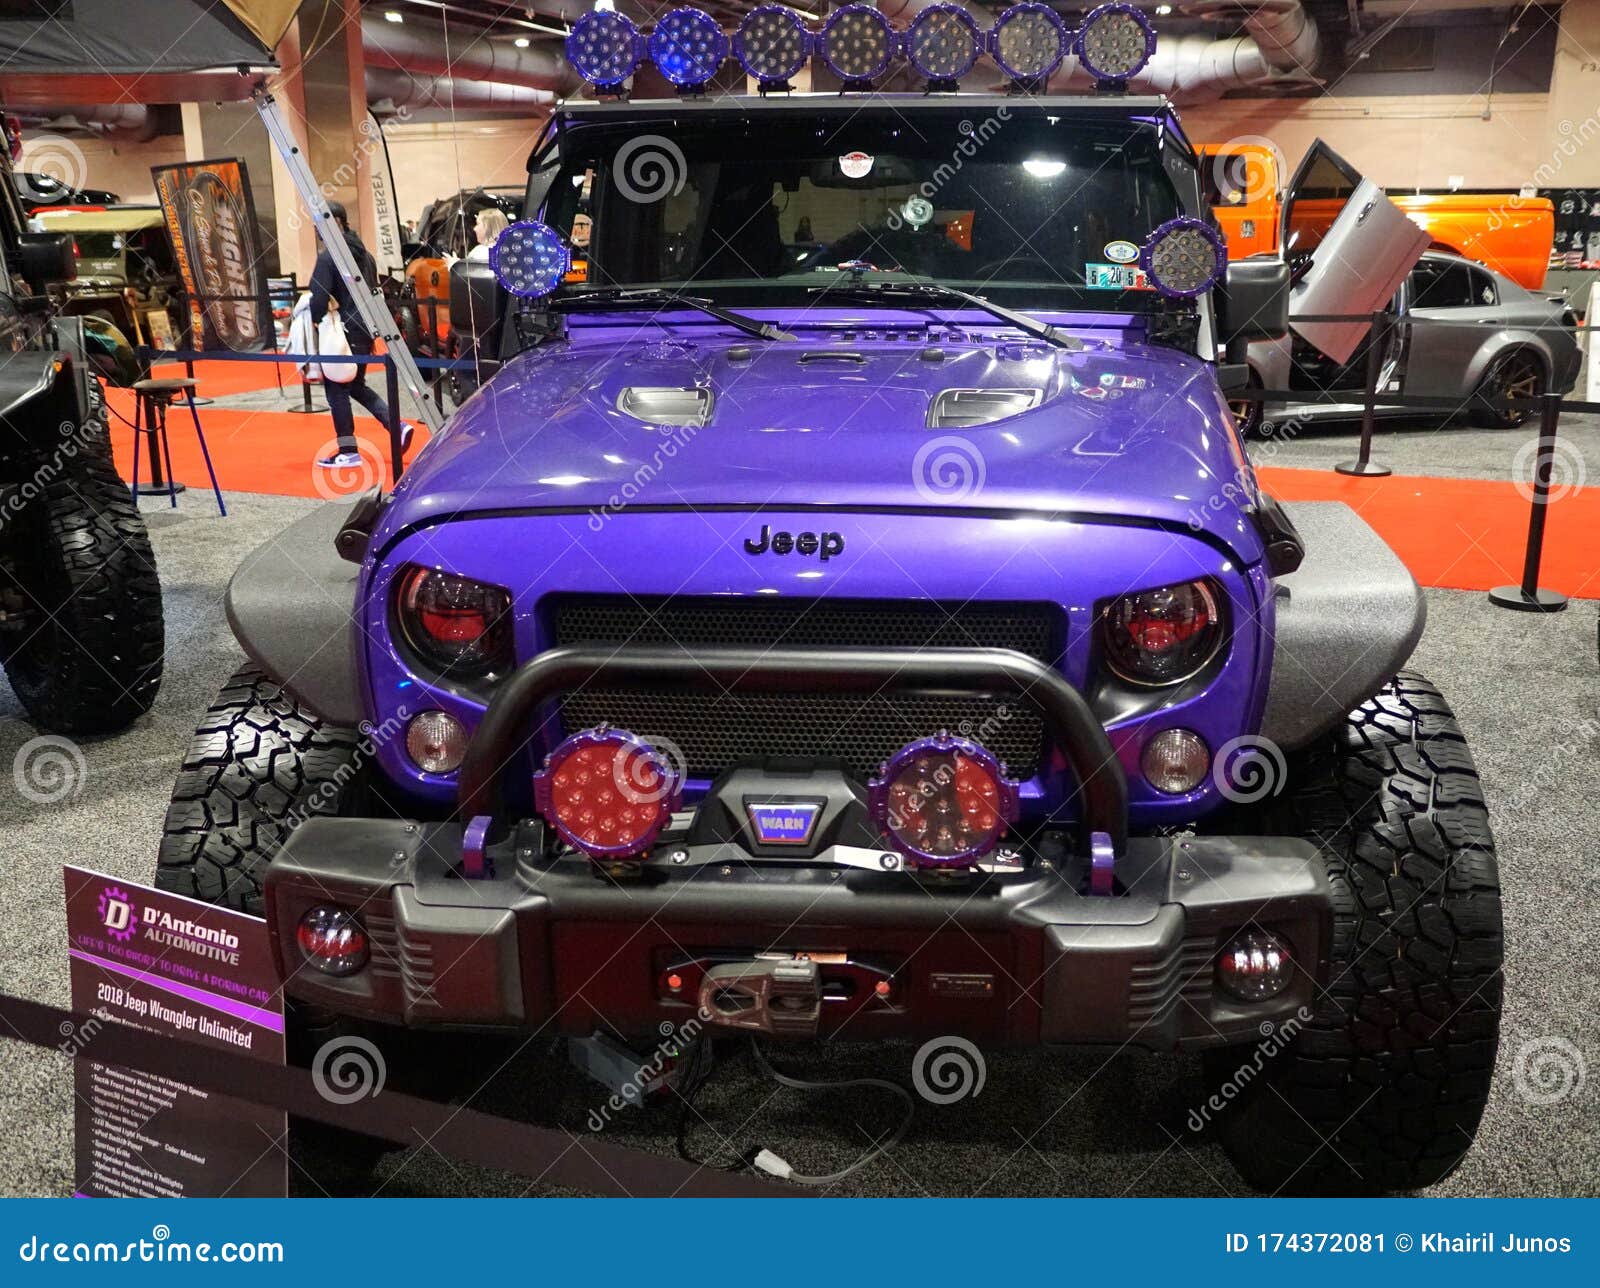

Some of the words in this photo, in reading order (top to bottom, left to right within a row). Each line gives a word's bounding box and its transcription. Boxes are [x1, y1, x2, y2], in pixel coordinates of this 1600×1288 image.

[371, 171, 390, 223] JERSEY
[379, 224, 395, 257] NEW
[213, 200, 258, 338] HIGHEND
[1091, 270, 1097, 285] 5
[1110, 266, 1121, 284] 20
[1127, 271, 1134, 286] 5
[743, 524, 845, 563] Jeep
[761, 816, 805, 830] WARN
[104, 898, 131, 930] D
[143, 906, 239, 948] D'Antonio
[144, 927, 240, 966] AUTOMOTIVE
[107, 942, 125, 956] TOO
[160, 958, 171, 971] TO
[172, 961, 200, 981] DRIVE
[203, 970, 209, 983] A
[211, 974, 247, 996] BORING
[249, 986, 269, 1001] CAR
[97, 982, 123, 1006] 2018
[124, 989, 148, 1017] Jeep
[149, 999, 198, 1030] Wrangler
[199, 1015, 252, 1049] Unlimited
